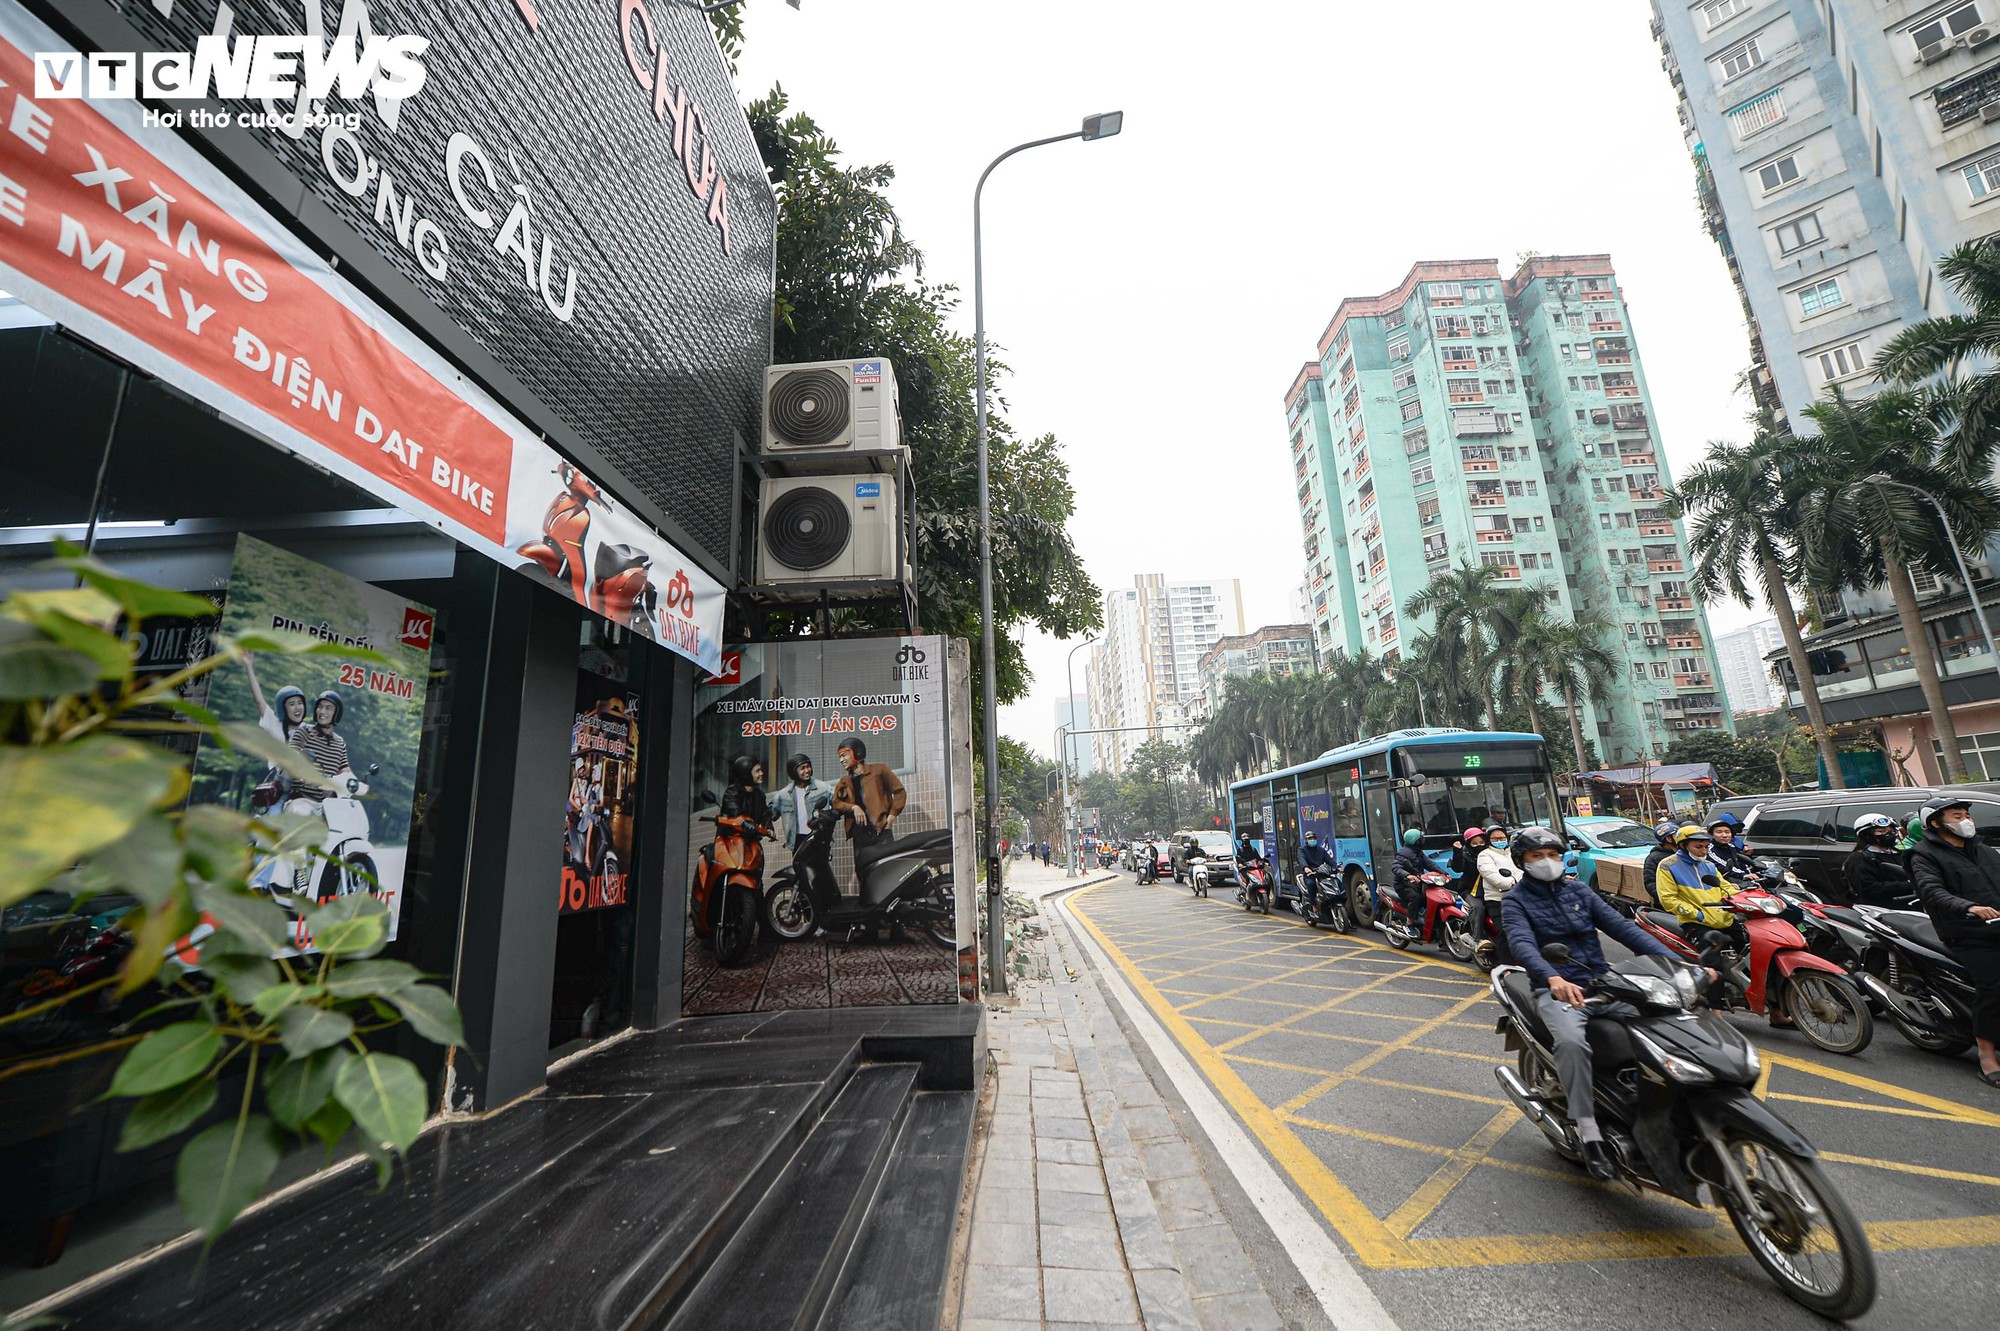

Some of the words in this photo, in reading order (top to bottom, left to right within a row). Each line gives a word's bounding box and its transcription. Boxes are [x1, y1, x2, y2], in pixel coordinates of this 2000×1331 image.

[0, 78, 54, 155] E
[72, 142, 269, 304] XĂNG
[445, 132, 577, 322] CẦU
[57, 213, 216, 336] MÁY
[232, 326, 342, 422] ĐIỆN
[353, 406, 425, 470] DAT
[431, 456, 495, 516] BIKE
[659, 608, 699, 656] DAT.BIKE
[339, 663, 365, 688] 25
[369, 670, 415, 700] NĂM
[892, 665, 929, 681] DAT.BIKE
[717, 701, 733, 713] XE
[736, 697, 762, 712] MÁY
[766, 697, 794, 714] ĐIỆN
[798, 698, 819, 709] DAT
[823, 696, 848, 707] BIKE
[852, 694, 910, 706] QUANTUM
[913, 693, 921, 704] S
[742, 719, 800, 737] 285KM
[806, 719, 816, 735] /
[820, 711, 854, 733] LẦN
[859, 714, 897, 735] SẠC
[1464, 755, 1481, 768] 29
